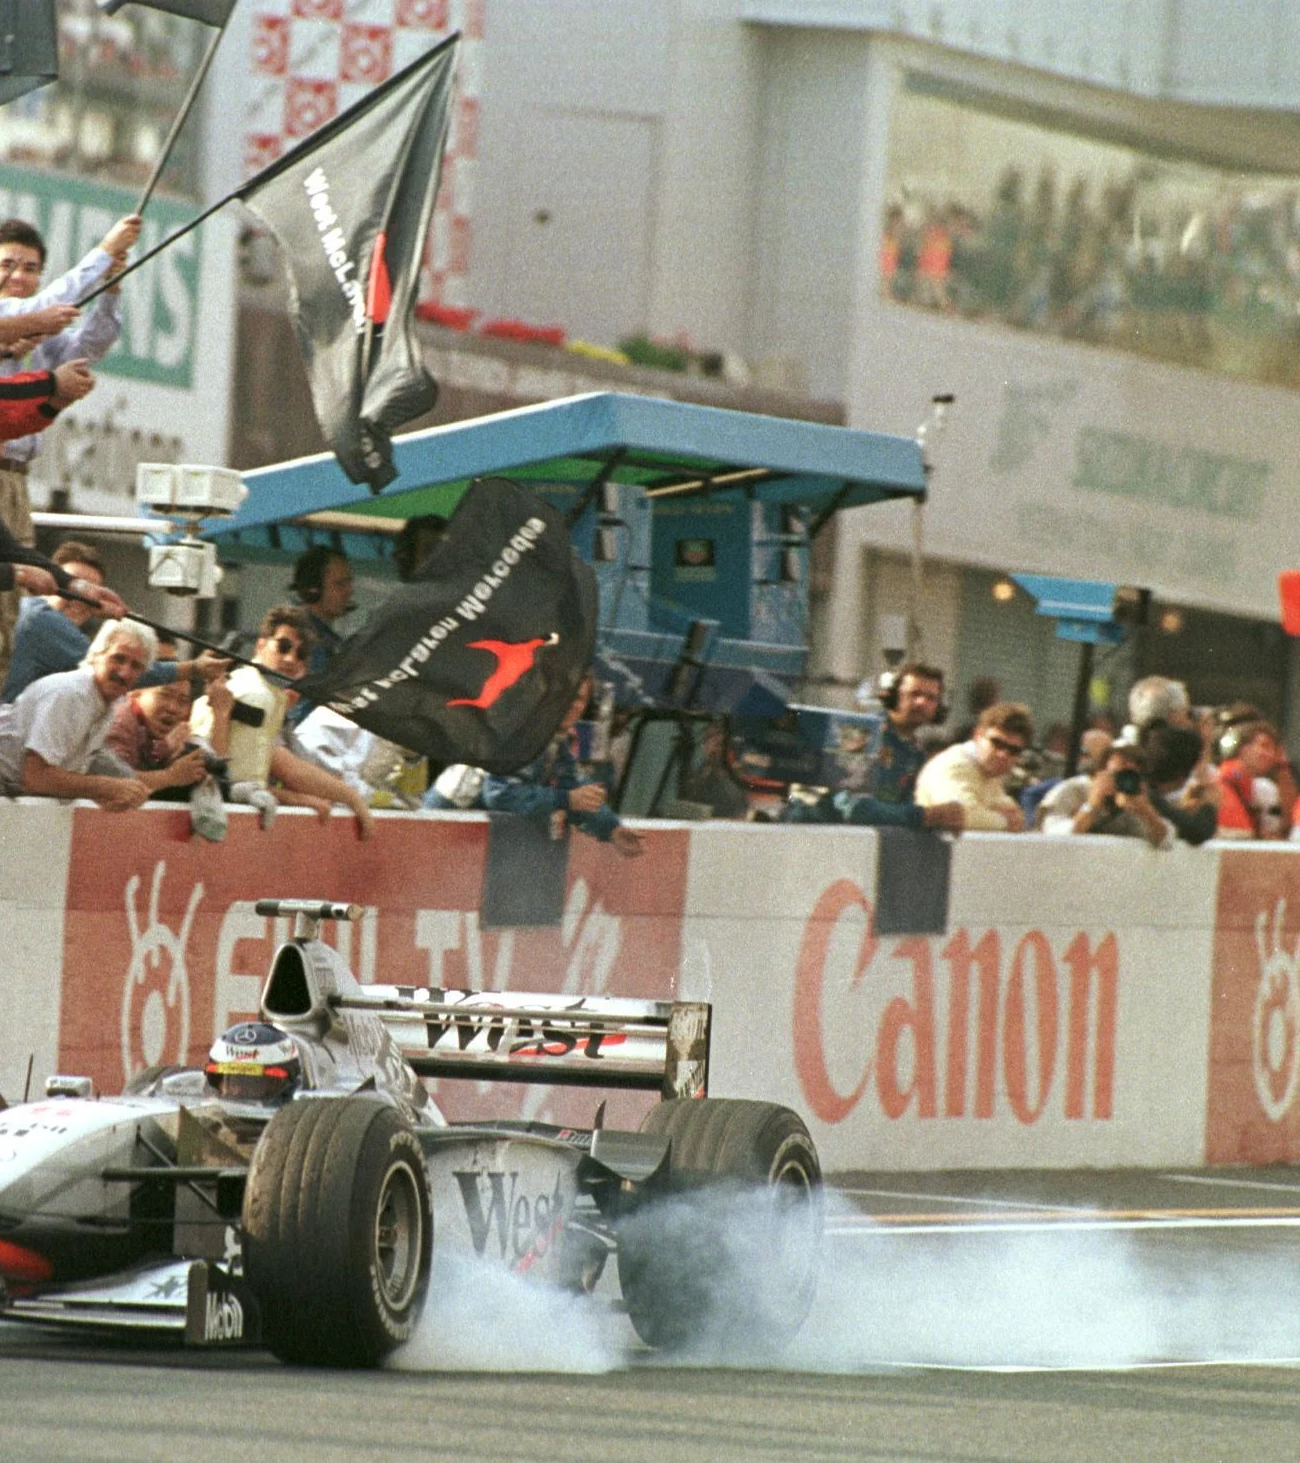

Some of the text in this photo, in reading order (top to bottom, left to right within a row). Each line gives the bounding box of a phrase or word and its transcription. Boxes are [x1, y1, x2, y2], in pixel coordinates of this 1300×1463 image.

[404, 986, 618, 1060] West
[791, 877, 1120, 1126] Canon
[451, 1169, 565, 1264] West
[204, 1291, 244, 1341] Mobil
